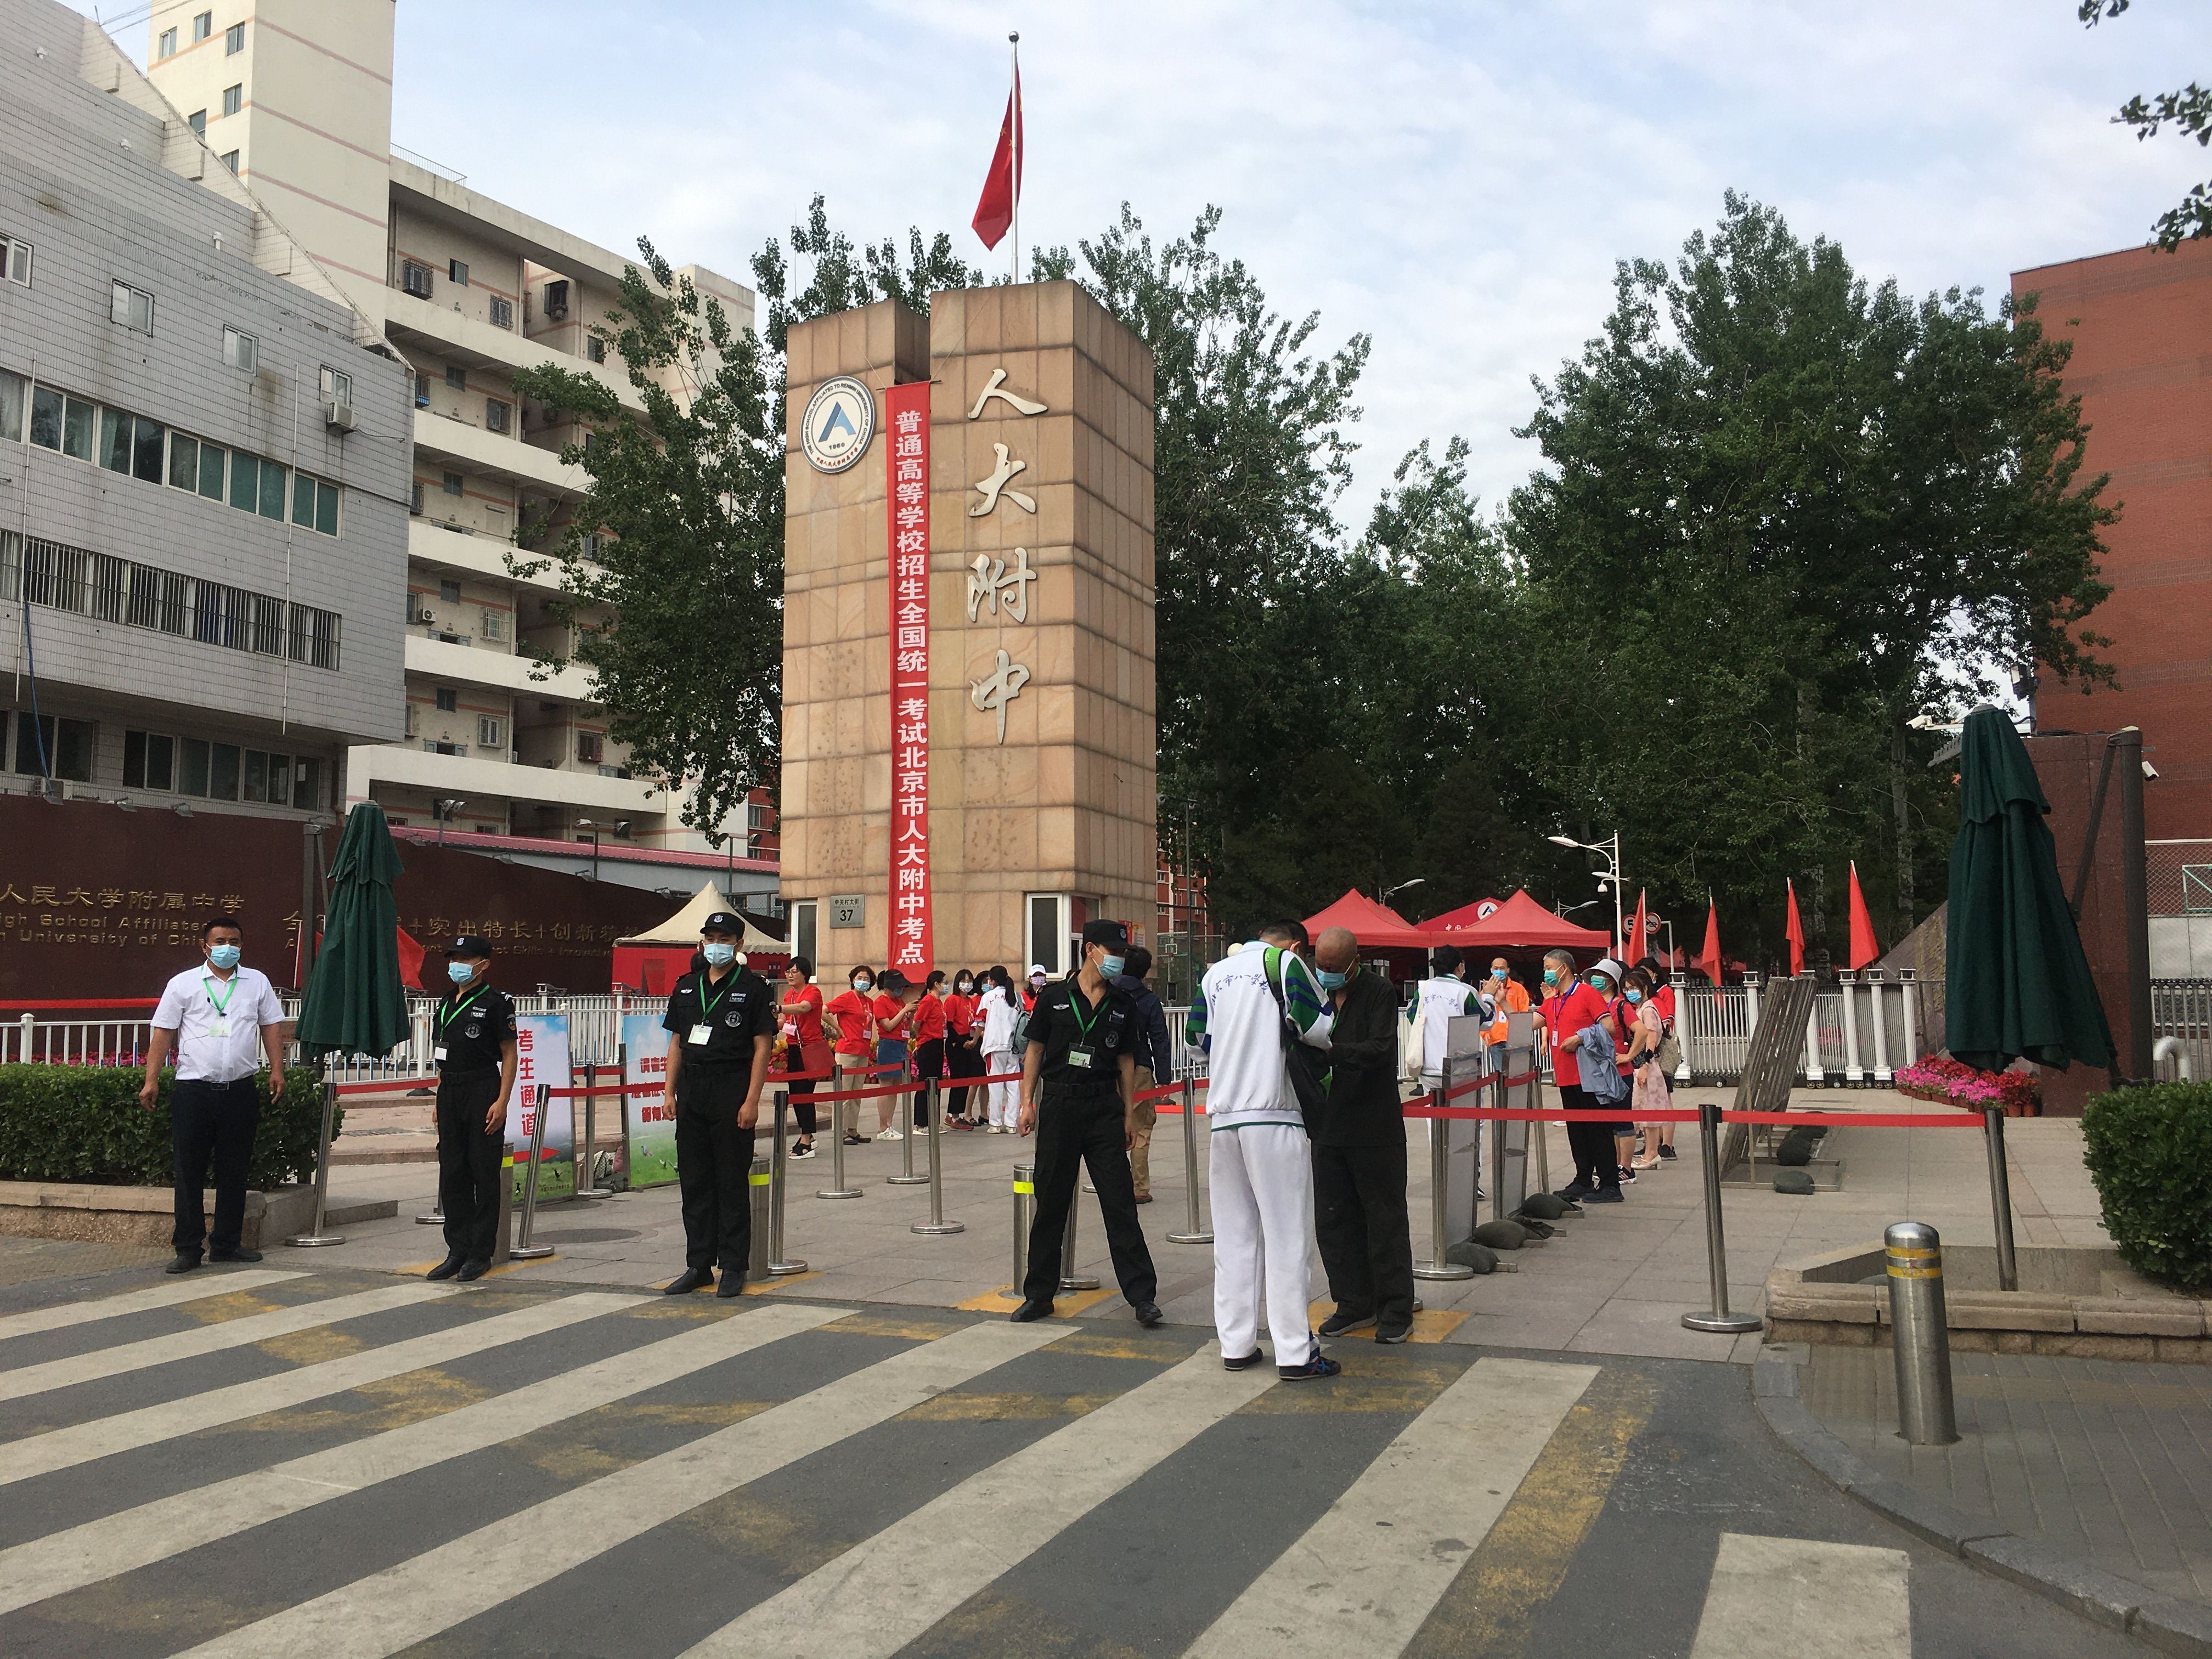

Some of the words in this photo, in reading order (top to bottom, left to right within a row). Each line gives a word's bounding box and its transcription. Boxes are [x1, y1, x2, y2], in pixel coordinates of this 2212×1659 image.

[840, 383, 857, 393] RENMIN
[812, 386, 834, 409] AFFILIATED
[856, 390, 869, 418] UNIVERSITY
[806, 409, 815, 430] SCHOOL
[865, 419, 869, 427] OF
[859, 427, 867, 444] CHINA
[967, 368, 1048, 744] 人大附中
[895, 410, 927, 964] 普通高等学校招生全国统一考试北京市人大附中考点
[40, 914, 108, 926] School
[119, 917, 211, 930] Affiliate
[840, 909, 854, 922] 37
[1445, 923, 1469, 932] 中国
[20, 930, 127, 947] University
[139, 934, 157, 946] of
[168, 934, 204, 946] Chi
[518, 1029, 536, 1136] 考生通道
